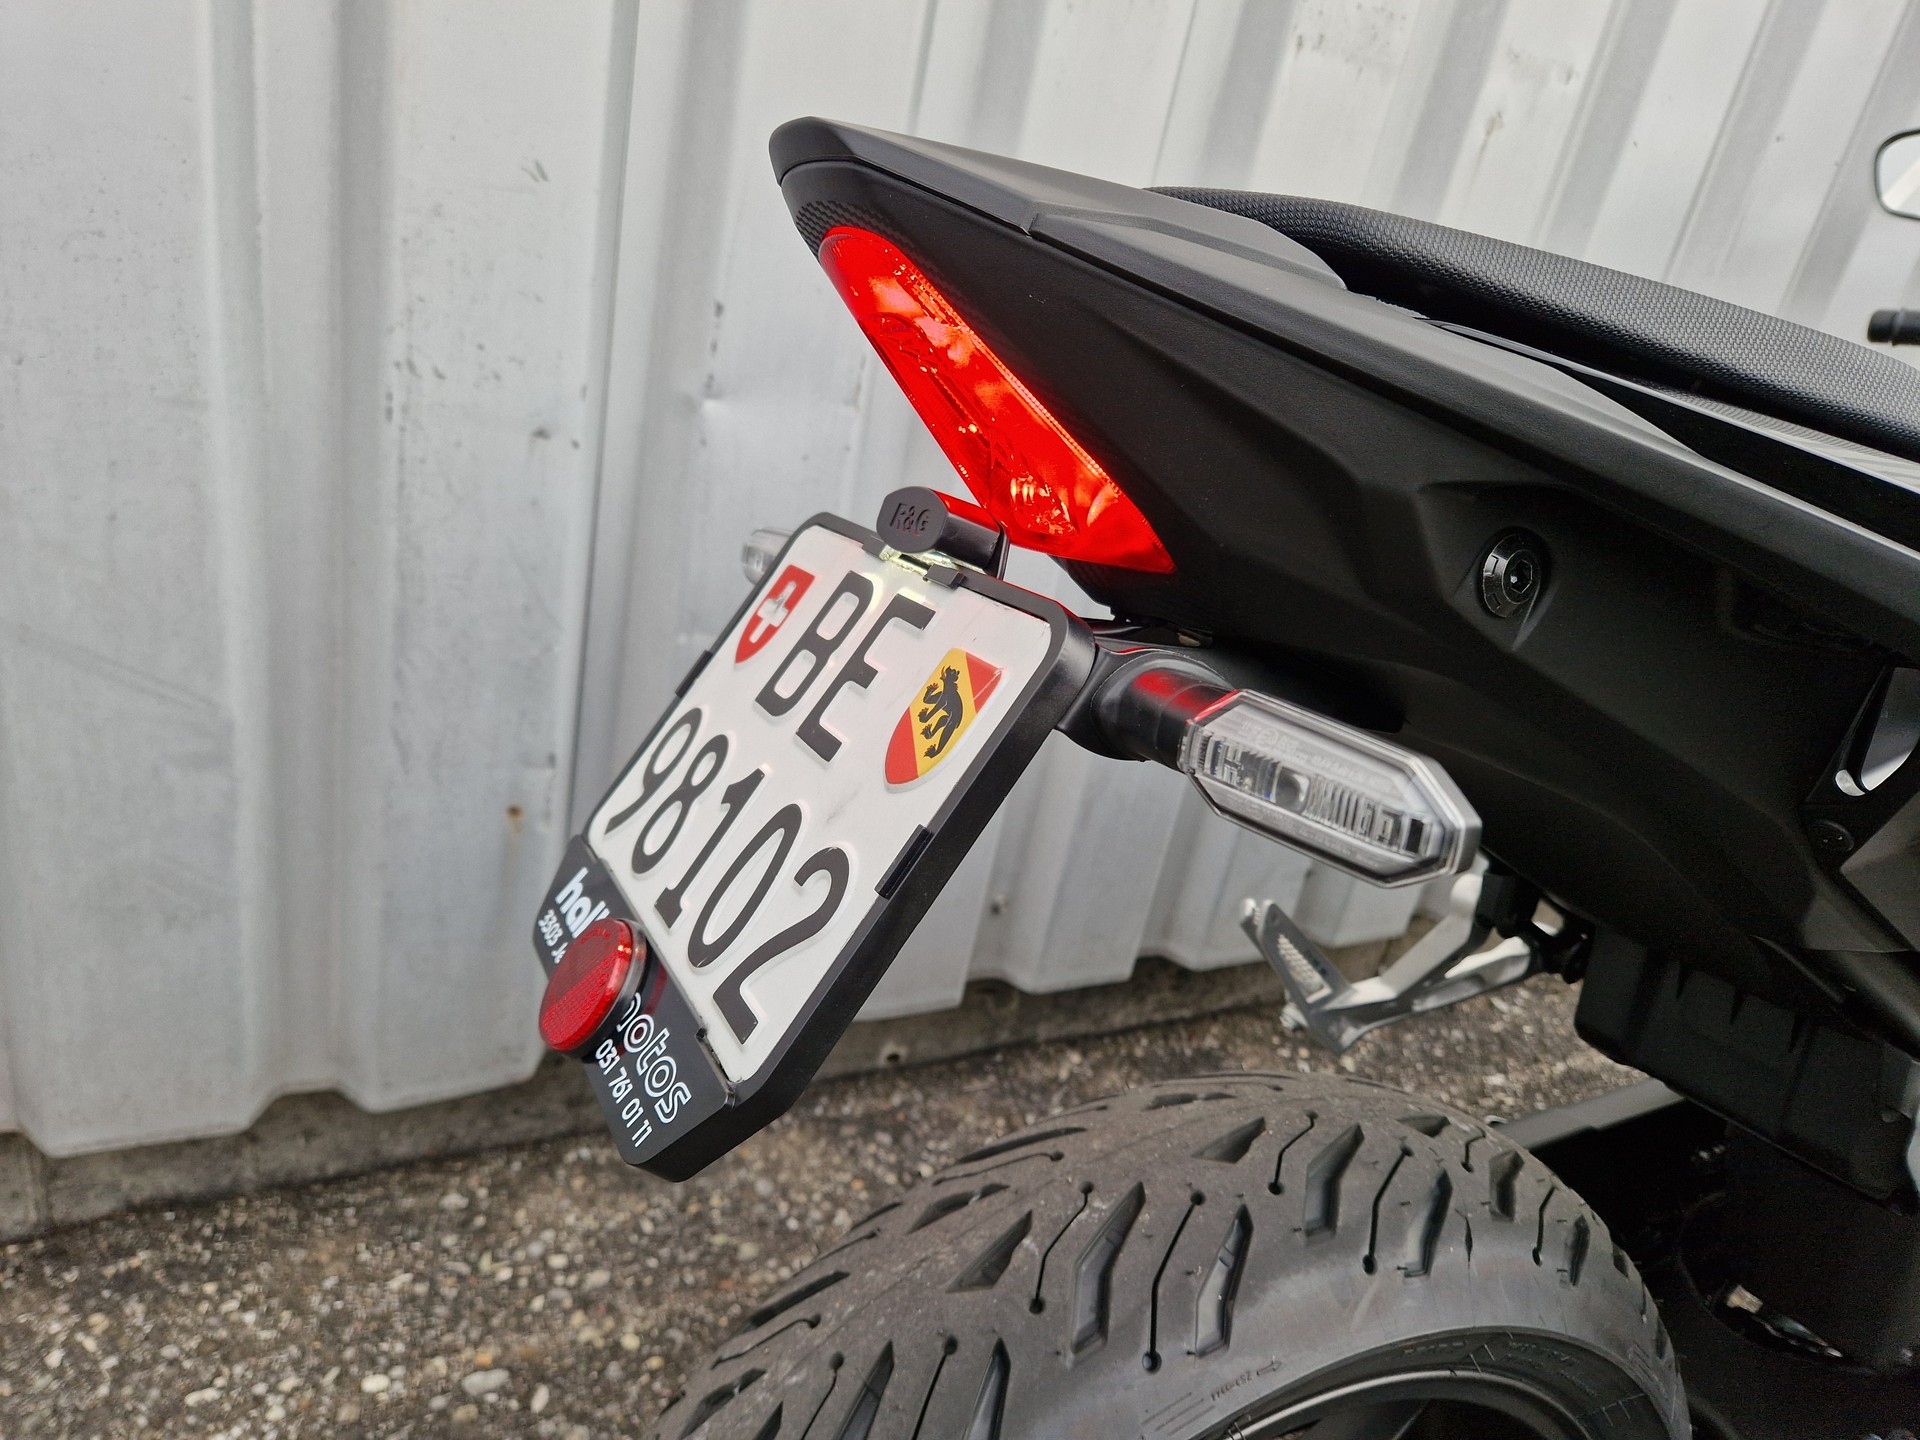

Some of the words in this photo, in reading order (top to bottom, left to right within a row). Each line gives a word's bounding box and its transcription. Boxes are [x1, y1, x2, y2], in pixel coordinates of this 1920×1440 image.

[888, 502, 932, 535] R&G
[755, 570, 936, 762] BE
[604, 707, 850, 1045] 98102
[595, 1038, 621, 1075] 031
[608, 1066, 634, 1104] 761
[621, 1097, 644, 1128] 01
[631, 1118, 653, 1148] 11
